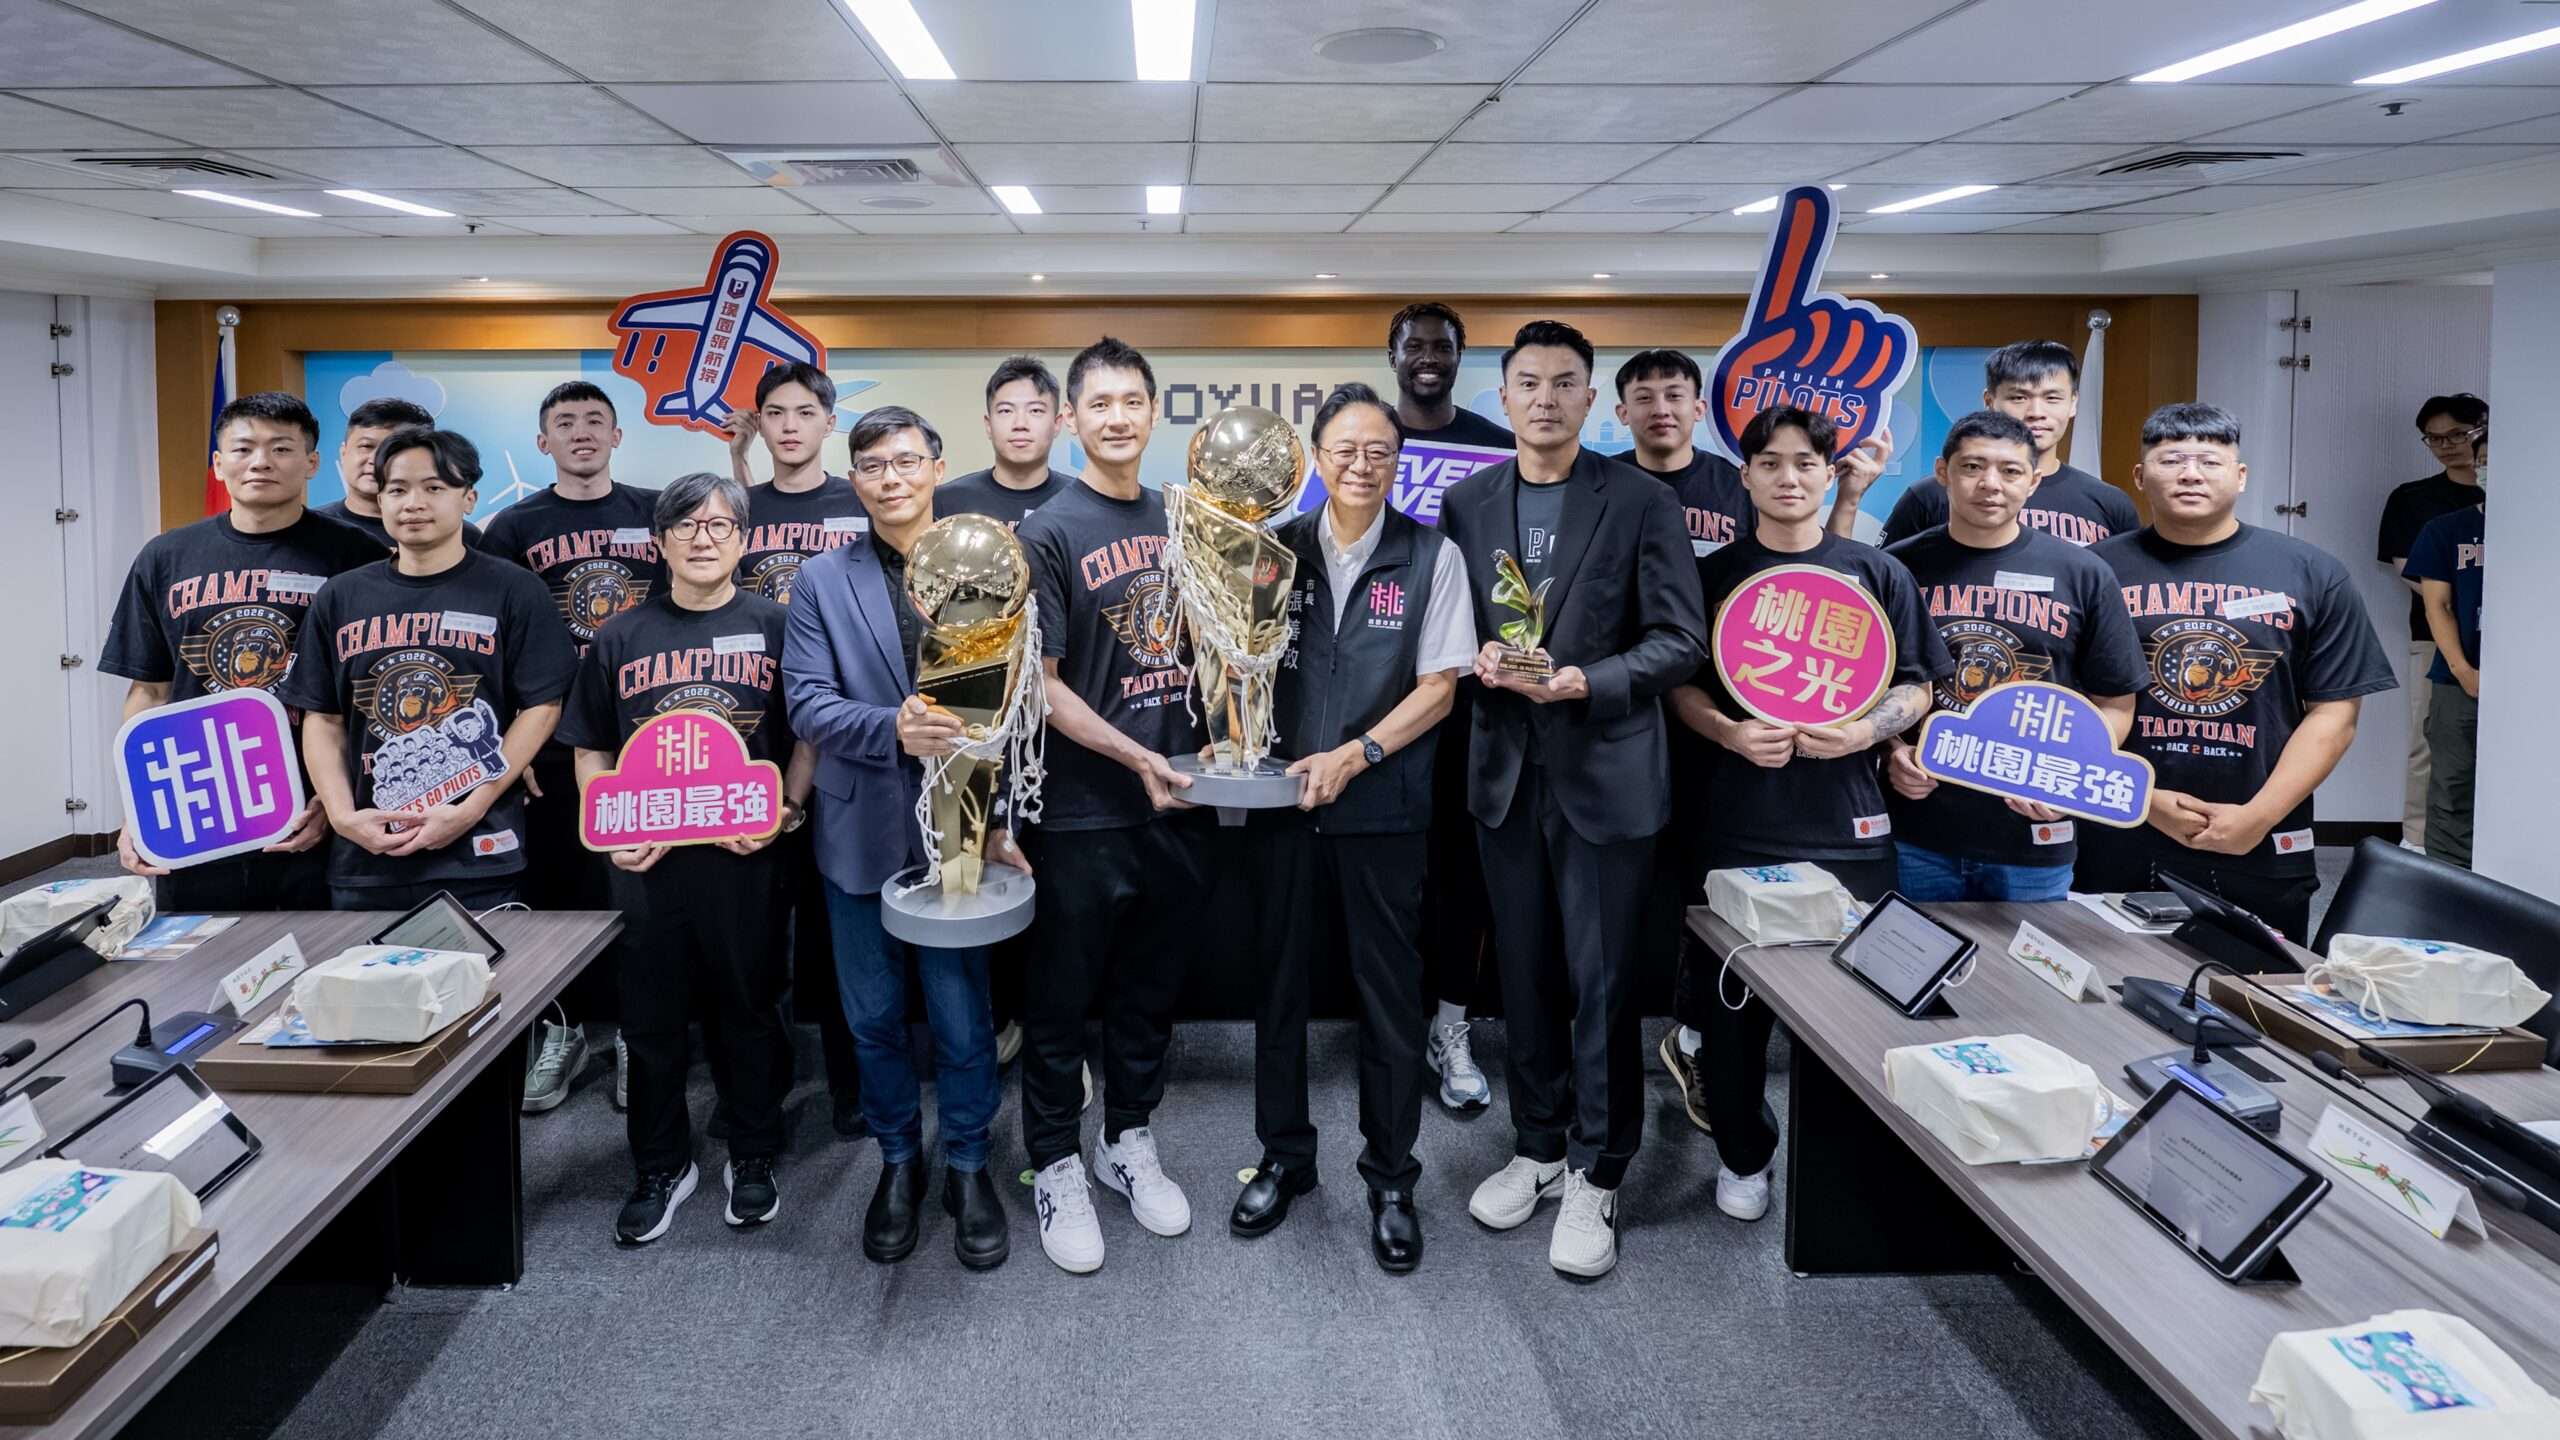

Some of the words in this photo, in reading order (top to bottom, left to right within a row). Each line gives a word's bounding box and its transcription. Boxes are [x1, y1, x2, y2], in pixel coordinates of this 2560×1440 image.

[1764, 368, 1844, 389] PAUIAN
[1731, 376, 1865, 429] PILOTS
[236, 608, 265, 618] 2026
[1284, 590, 1303, 670] 張善政
[1749, 582, 1873, 660] 桃園
[1919, 584, 2071, 639] AMPIONS
[1963, 623, 1992, 634] 2026
[2184, 622, 2212, 631] 2026
[399, 652, 426, 661] 2026
[618, 647, 777, 700] CHAMPIONS
[684, 687, 710, 697] 2026
[1732, 638, 1855, 715] 之光
[2154, 690, 2195, 713] PAUIAN
[2200, 695, 2242, 714] PILOTS
[2138, 715, 2257, 748] TAOYUAN
[2166, 743, 2189, 753] BACK
[2192, 744, 2201, 754] 2
[2203, 745, 2227, 757] BACK
[426, 788, 443, 807] GO
[443, 764, 483, 797] PILOTS
[1932, 728, 2136, 814] 桃園最強
[594, 781, 769, 835] 桃園最強
